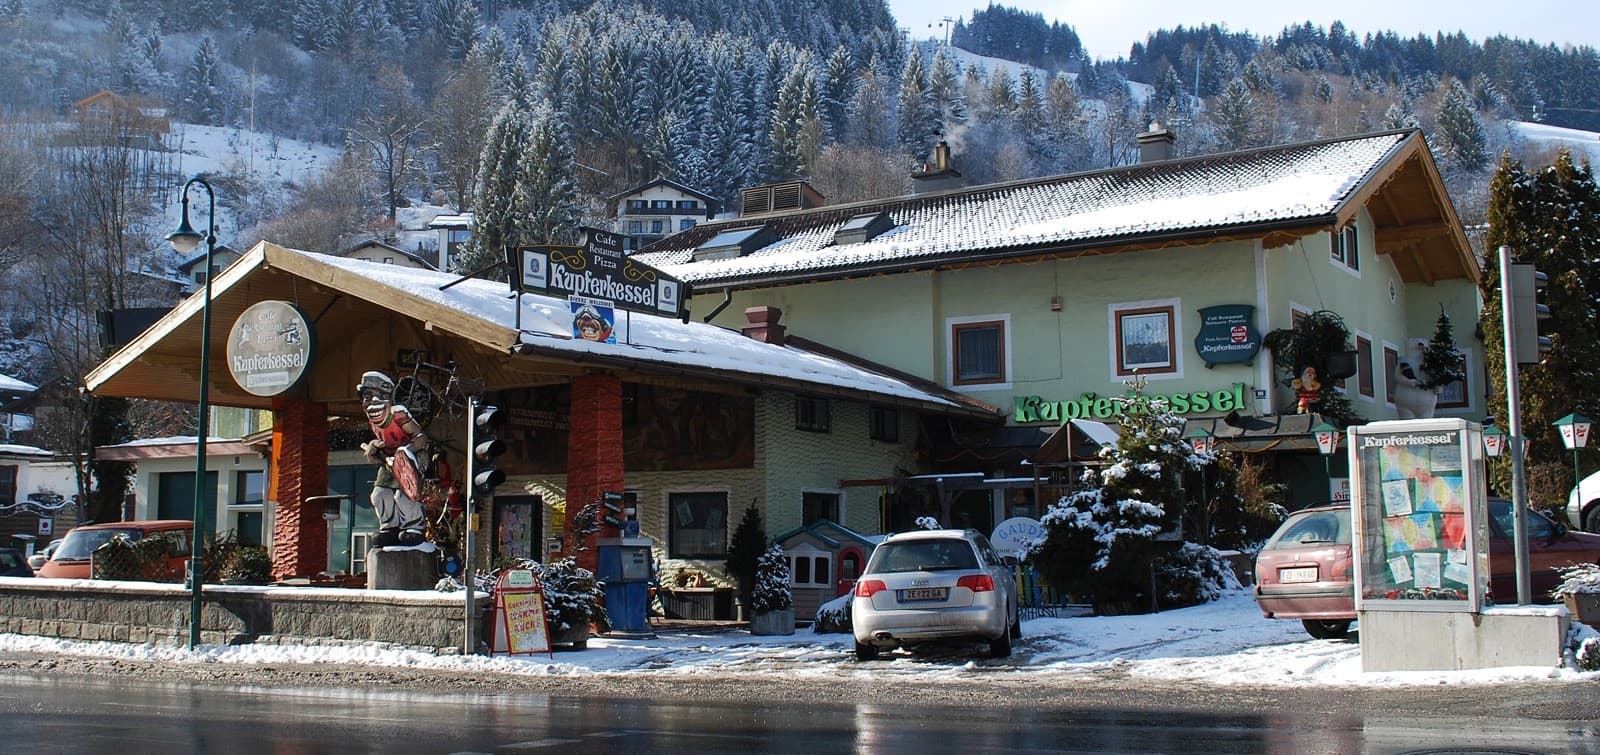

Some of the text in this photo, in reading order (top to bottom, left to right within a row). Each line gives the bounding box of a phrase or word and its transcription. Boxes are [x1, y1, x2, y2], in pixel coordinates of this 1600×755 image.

[595, 232, 617, 246] Cafe
[589, 242, 622, 259] Restaurant
[594, 255, 617, 269] Pizza
[550, 262, 656, 306] Kupferkessel
[233, 348, 304, 374] Kupferkessel
[1013, 382, 1246, 425] Kupferkessel
